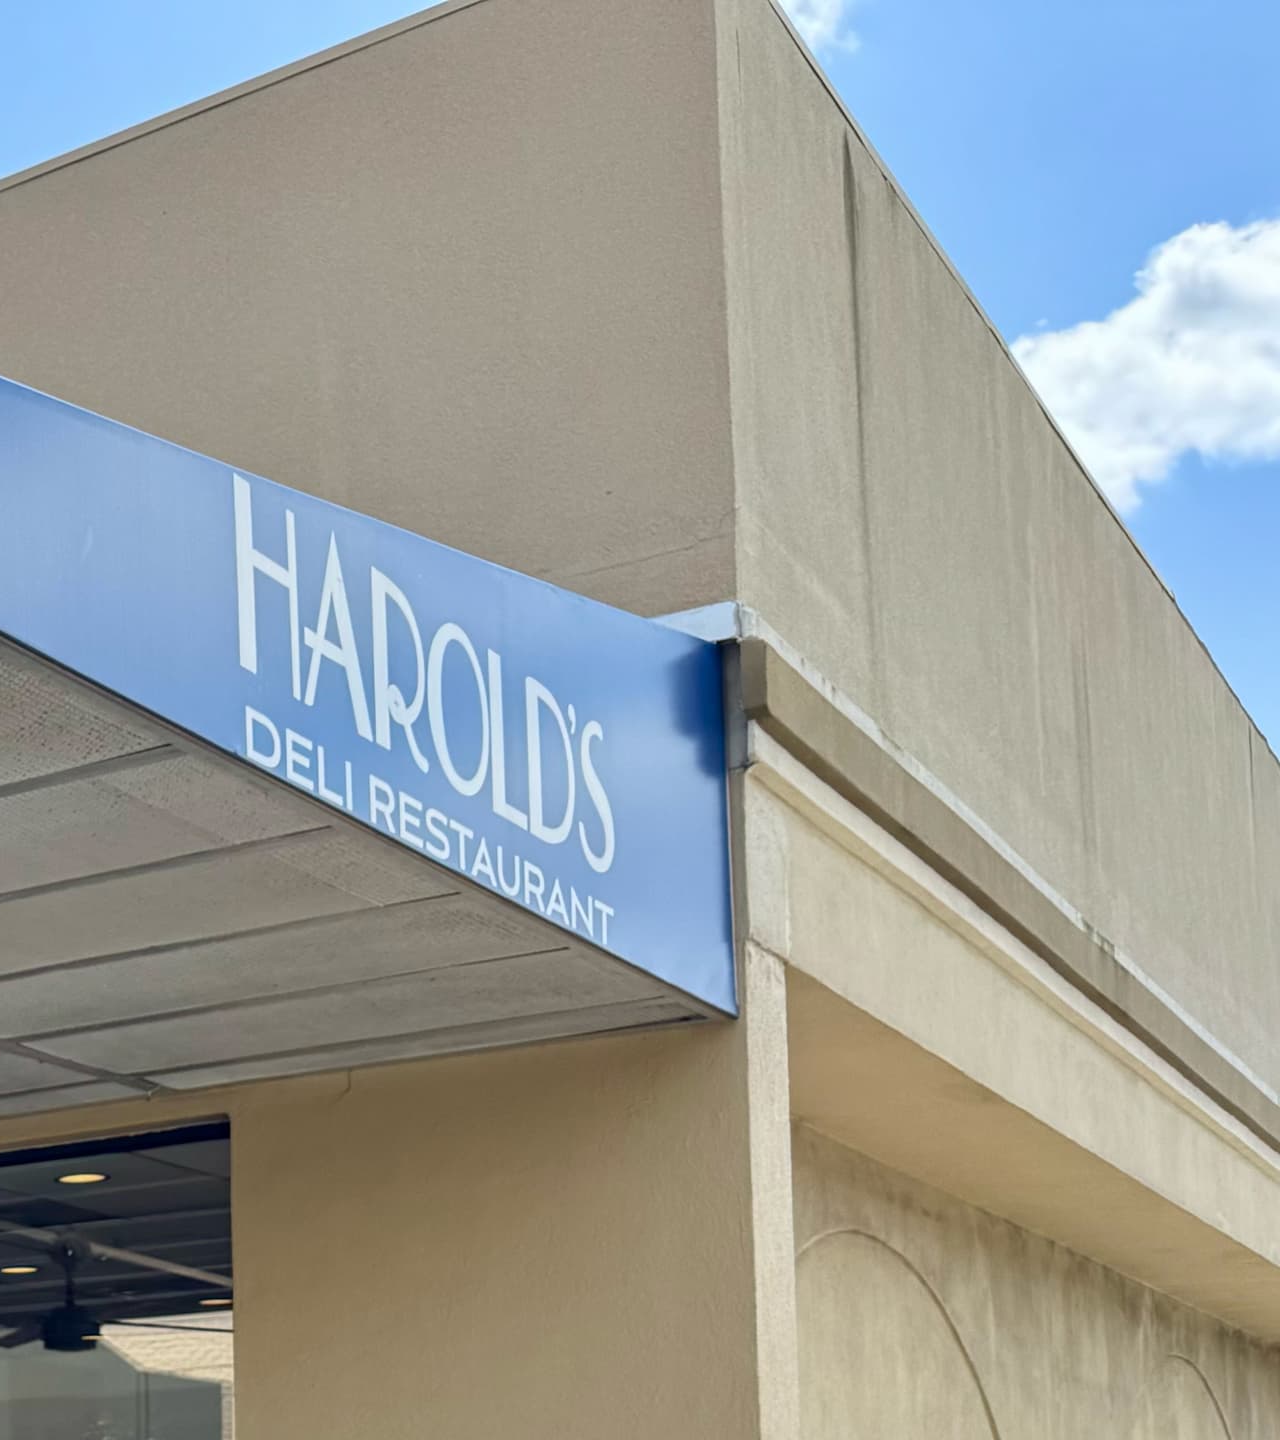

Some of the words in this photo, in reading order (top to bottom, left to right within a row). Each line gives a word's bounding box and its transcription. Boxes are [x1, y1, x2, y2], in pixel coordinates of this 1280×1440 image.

[233, 473, 615, 873] HAROLD'S
[244, 706, 352, 812] DELI
[369, 774, 615, 944] RESTAURANT
